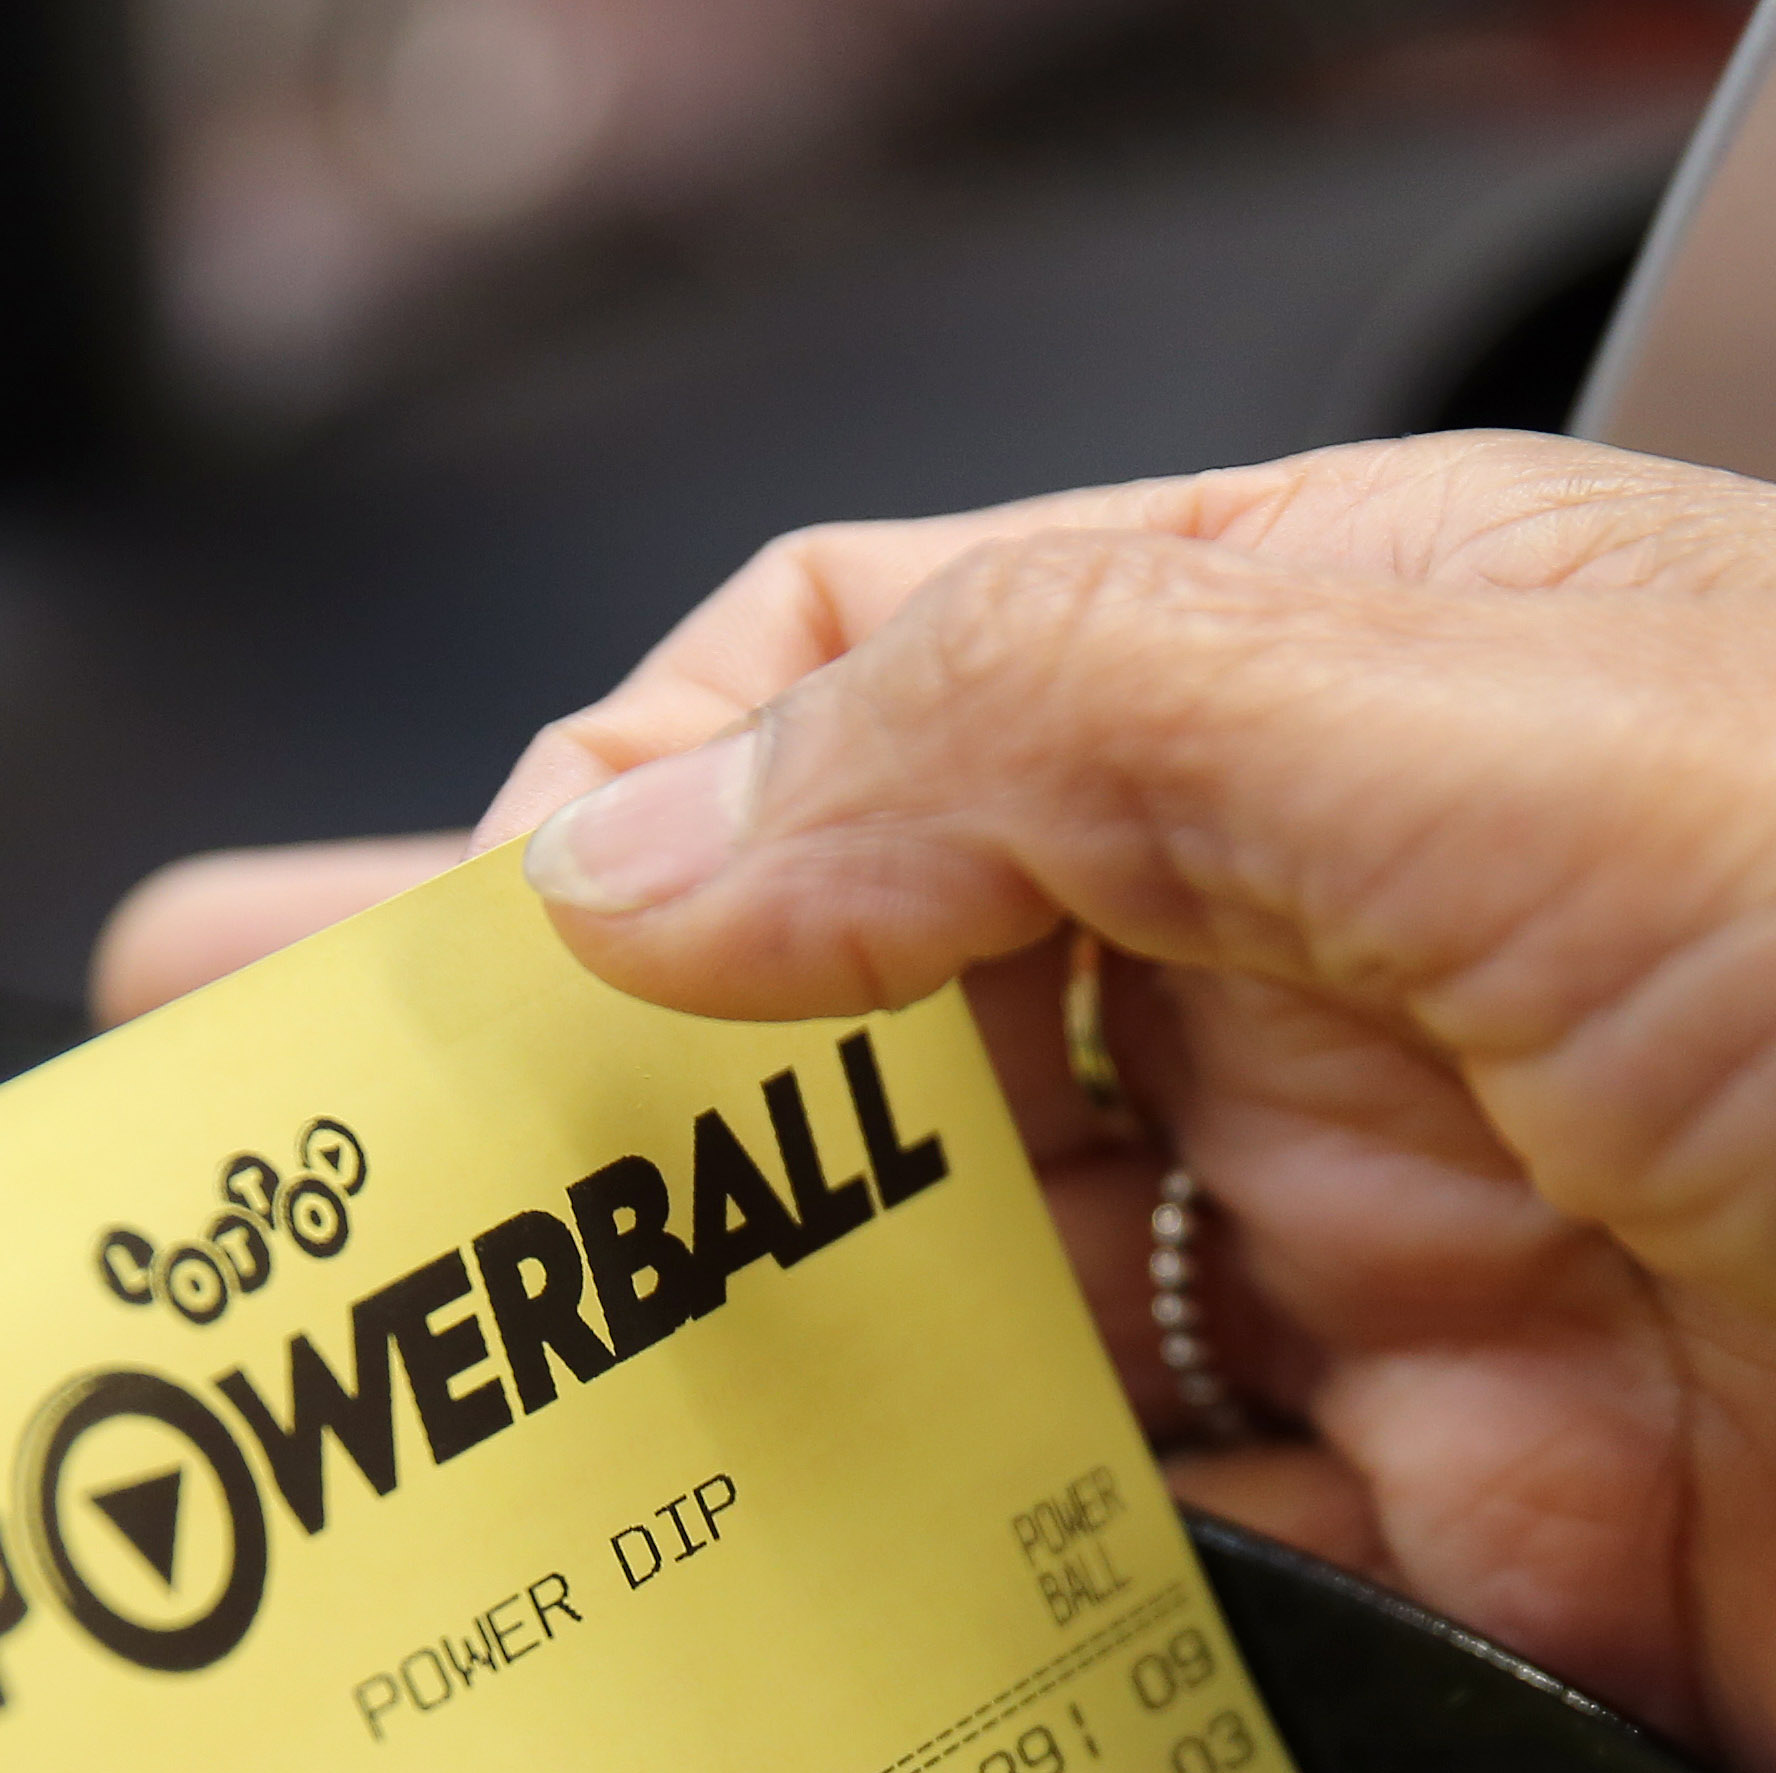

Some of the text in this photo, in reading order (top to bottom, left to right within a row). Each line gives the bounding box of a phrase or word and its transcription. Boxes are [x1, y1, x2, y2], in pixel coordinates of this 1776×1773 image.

[1012, 1464, 1126, 1569] POWER
[351, 1472, 739, 1740] POWER DIP
[1036, 1540, 1132, 1628] BALL
[1131, 1626, 1216, 1711] 09
